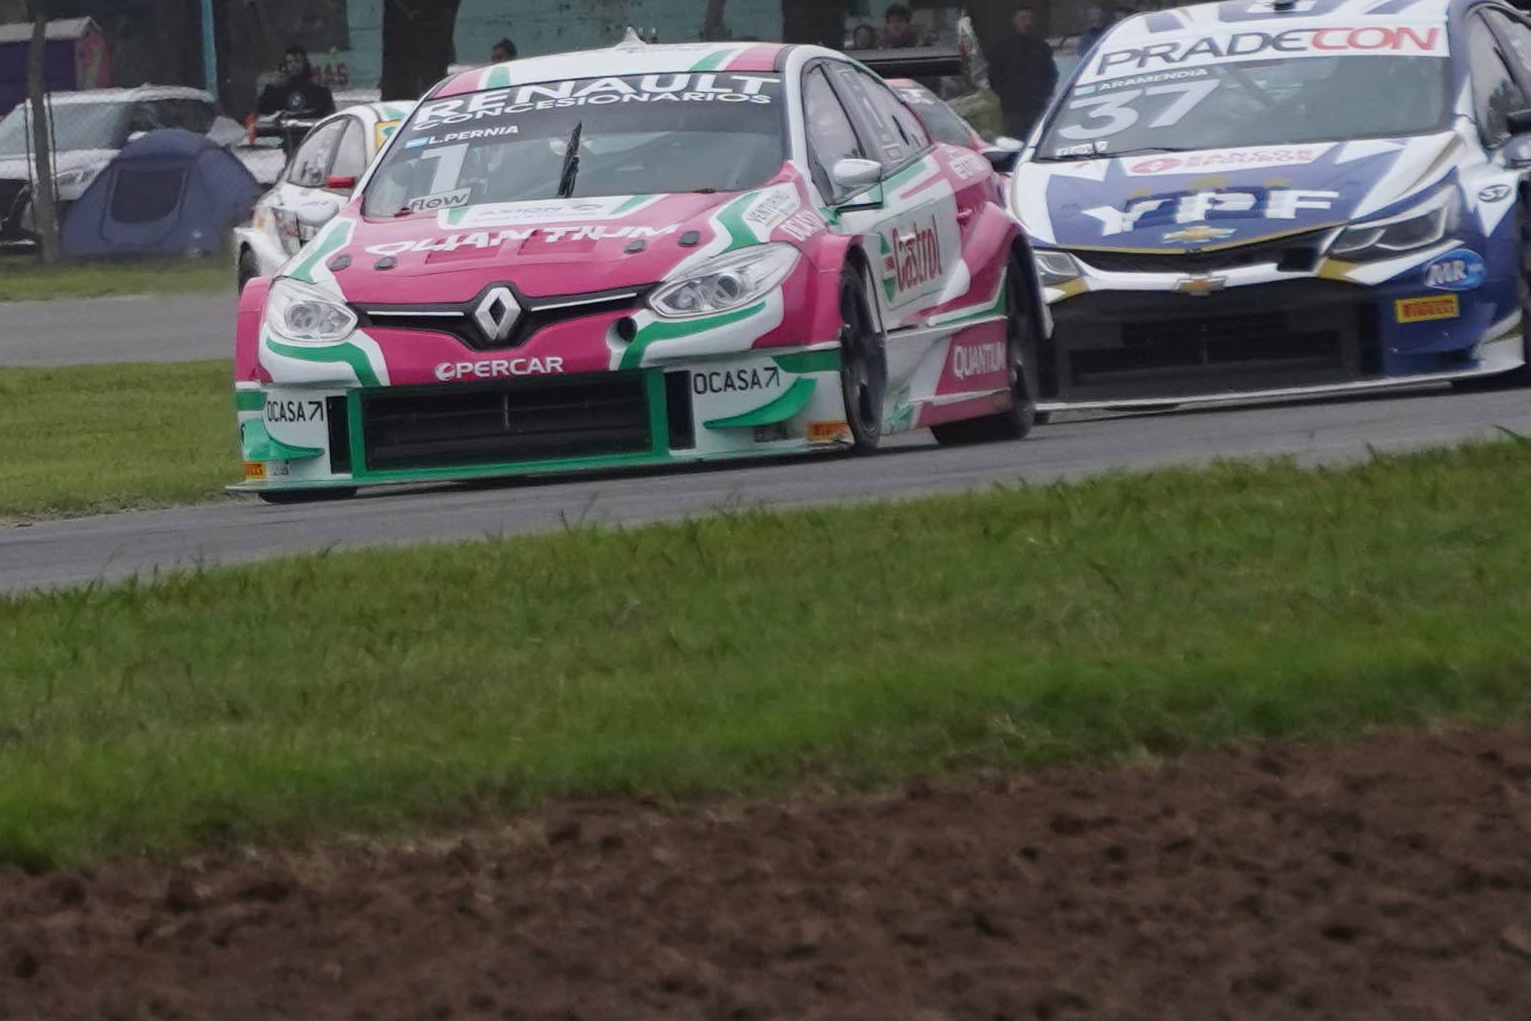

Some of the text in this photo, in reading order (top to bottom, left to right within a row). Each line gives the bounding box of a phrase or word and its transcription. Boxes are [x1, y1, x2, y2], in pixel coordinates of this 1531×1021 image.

[1096, 25, 1440, 77] PRADECON
[413, 73, 781, 125] RENAULT
[1098, 68, 1209, 92] ARAMENDIA
[412, 91, 773, 131] CONCESIONARIOS
[1058, 80, 1222, 140] 37
[427, 124, 519, 145] L.PERNIA
[420, 142, 470, 197] 1
[409, 192, 469, 213] flow
[1080, 189, 1340, 237] YPF
[364, 223, 682, 256] QUANTIUM
[892, 213, 944, 292] Castrol
[693, 368, 764, 396] OCASA
[267, 399, 307, 425] OCASA
